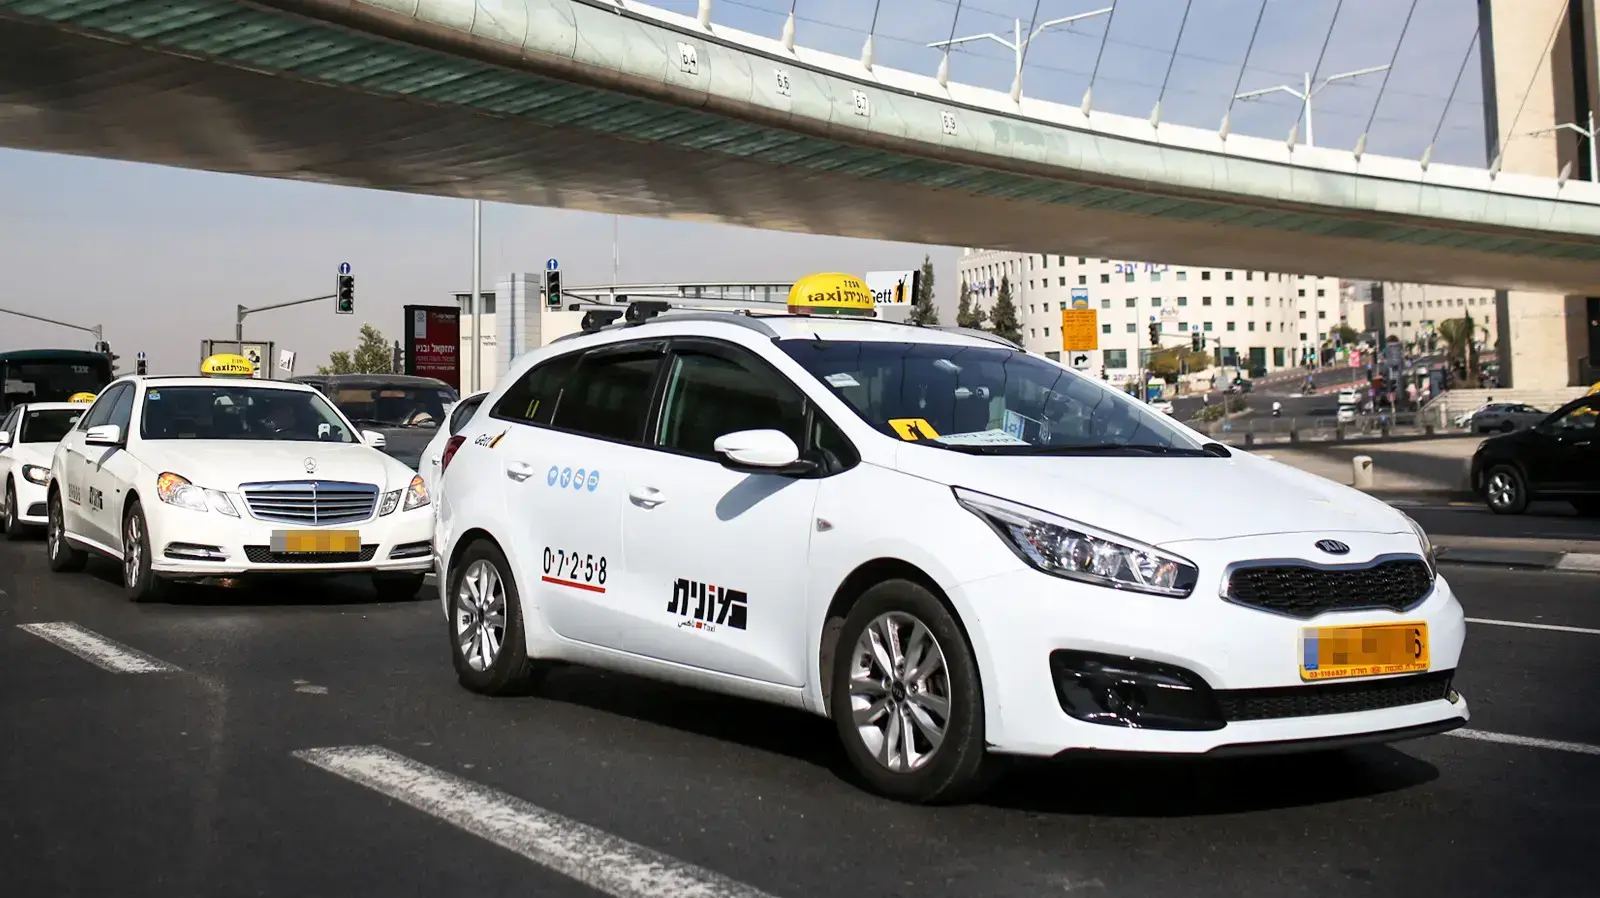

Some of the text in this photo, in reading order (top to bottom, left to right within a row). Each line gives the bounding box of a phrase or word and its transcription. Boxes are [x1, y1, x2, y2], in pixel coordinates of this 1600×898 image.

[808, 286, 870, 304] taxi מונית
[212, 363, 229, 372] taxi
[1320, 540, 1350, 551] KIA
[667, 577, 748, 630] מונית
[703, 622, 716, 632] Taxi
